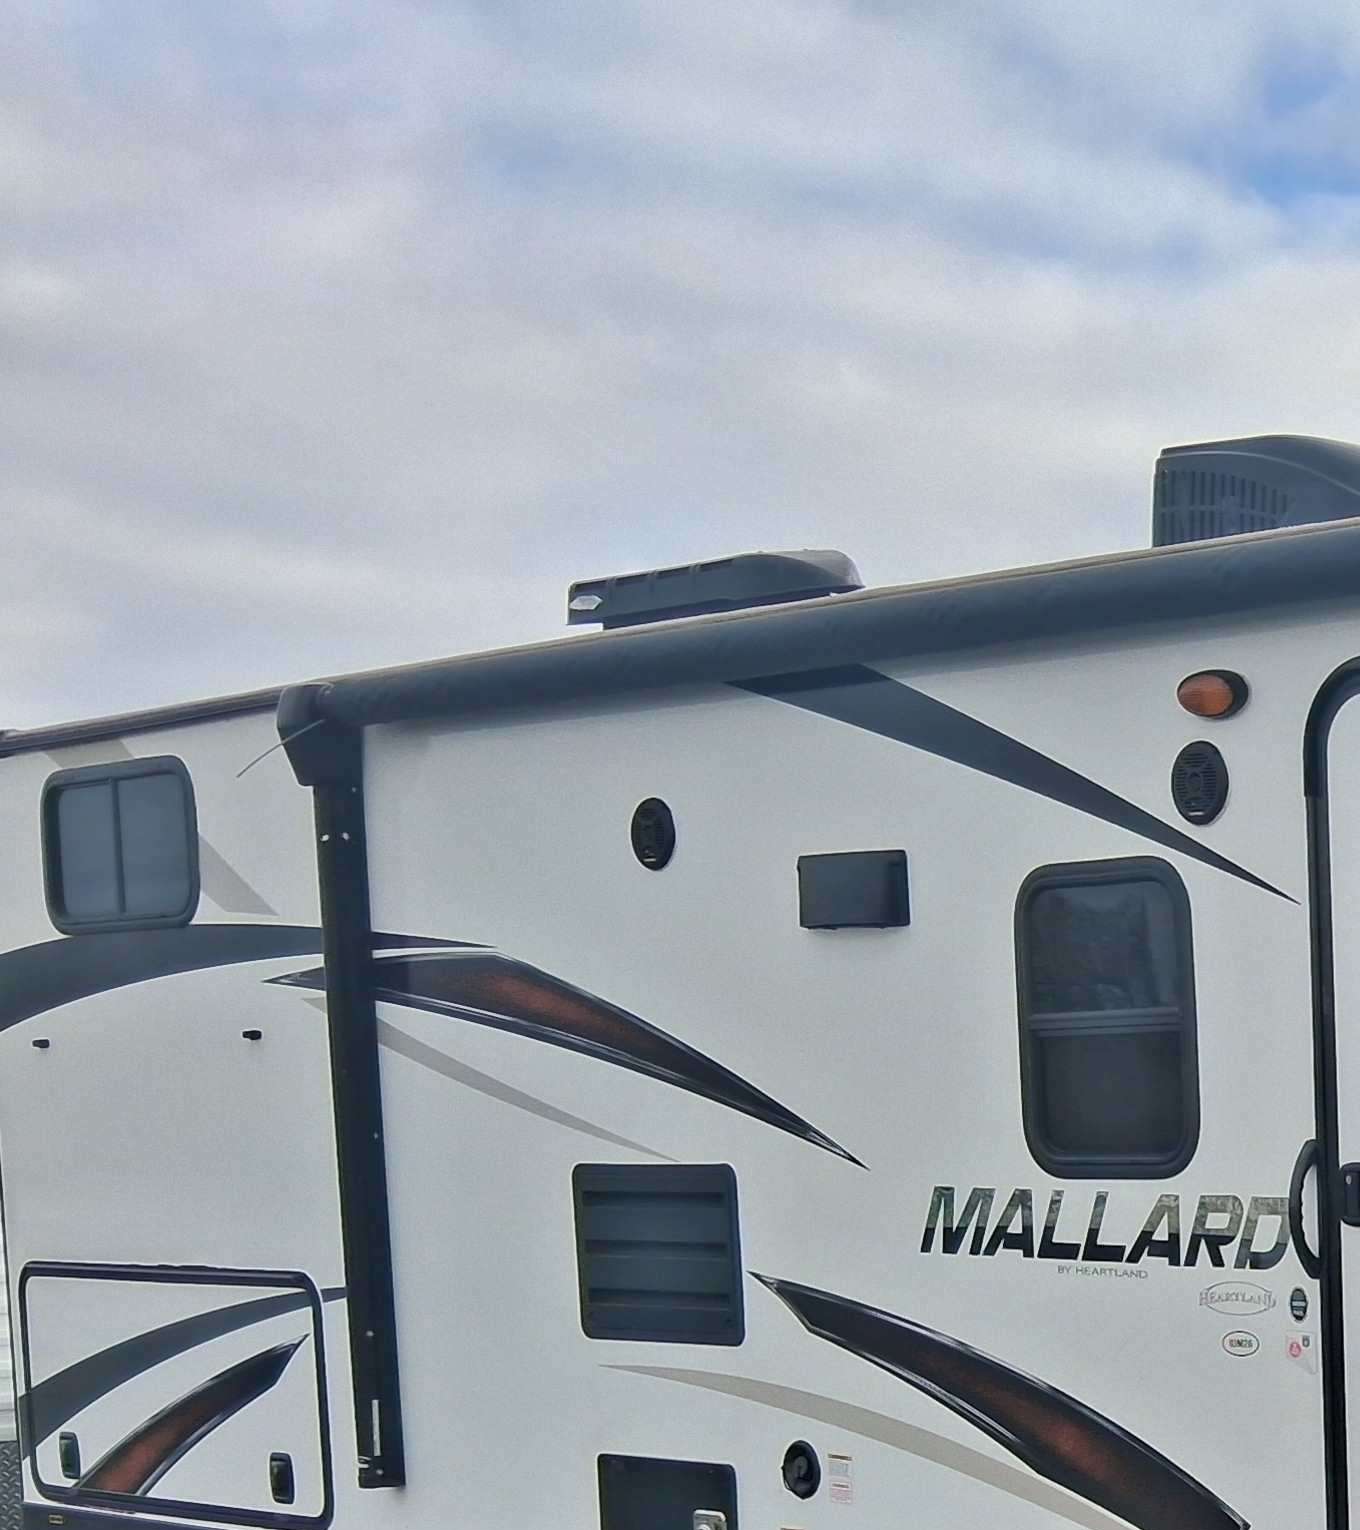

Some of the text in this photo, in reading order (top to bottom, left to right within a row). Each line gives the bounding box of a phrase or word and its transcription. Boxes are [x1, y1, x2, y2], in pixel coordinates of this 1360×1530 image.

[920, 1185, 1290, 1269] MALLARD
[1057, 1264, 1149, 1280] BY HEARTLAND
